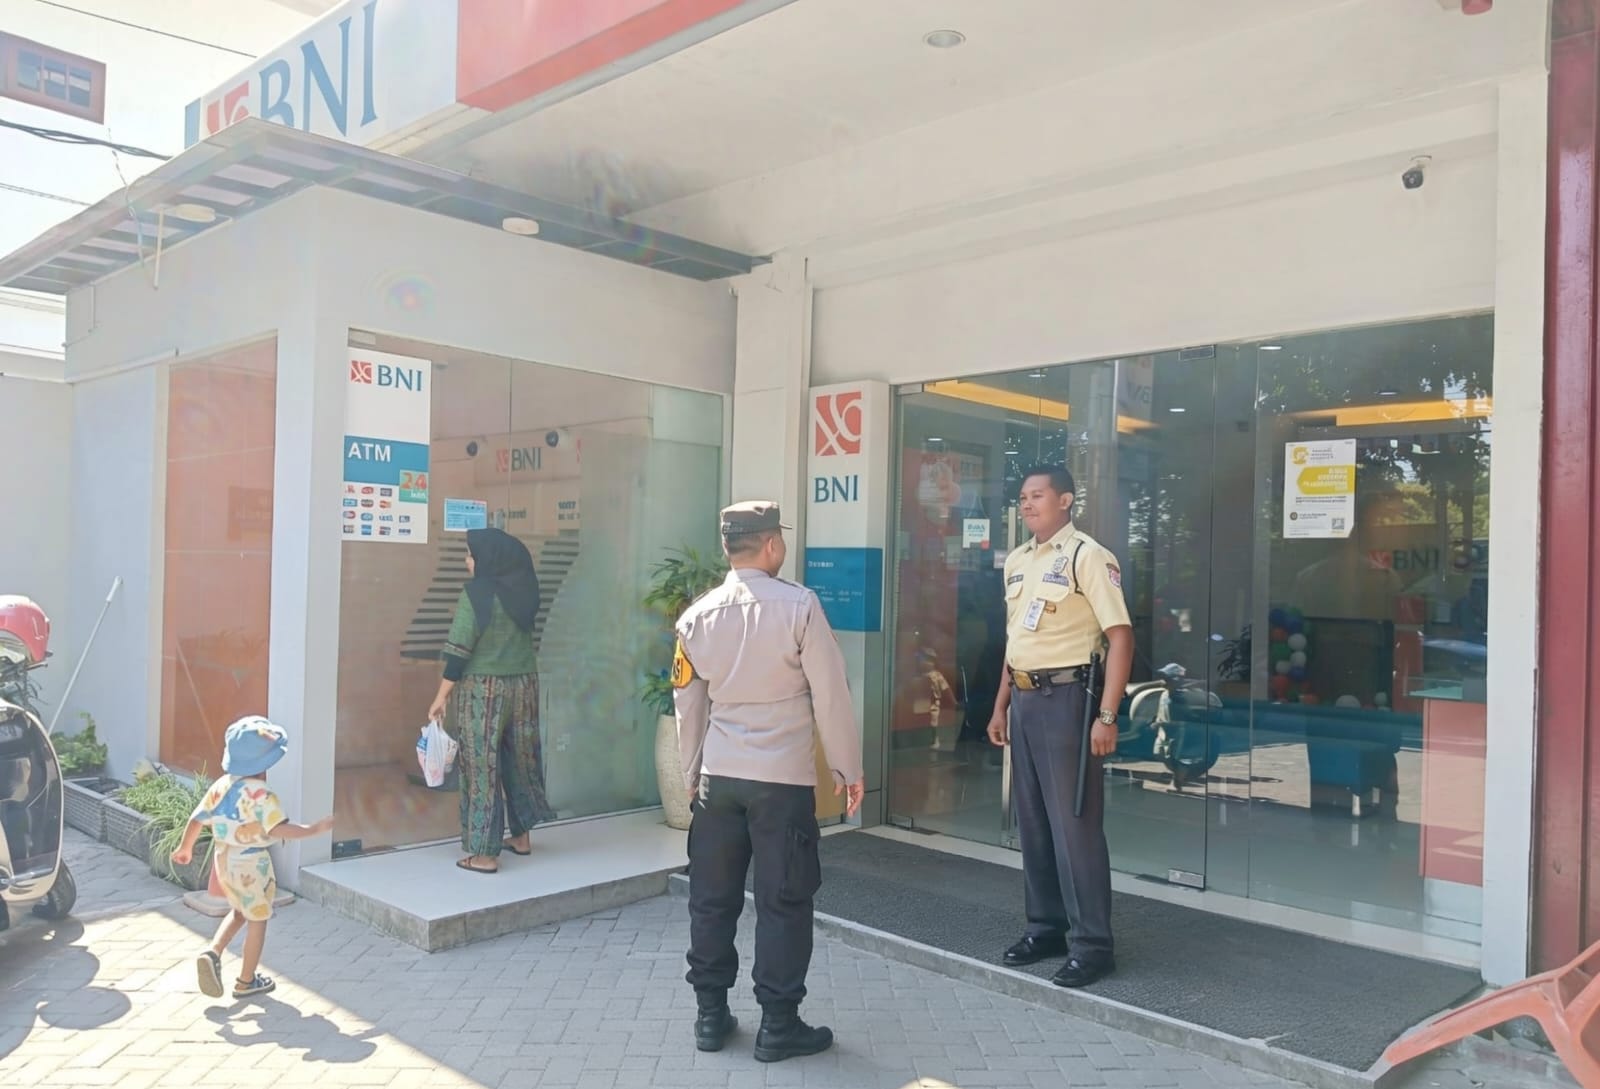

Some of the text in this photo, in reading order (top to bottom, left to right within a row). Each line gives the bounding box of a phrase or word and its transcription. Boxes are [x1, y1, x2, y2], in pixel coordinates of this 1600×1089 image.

[258, 0, 378, 137] BNI
[377, 364, 422, 392] BNI
[348, 442, 391, 463] ATM
[511, 447, 542, 471] BNI
[401, 471, 427, 489] 24
[814, 474, 858, 503] BNI
[1393, 548, 1439, 570] BNI
